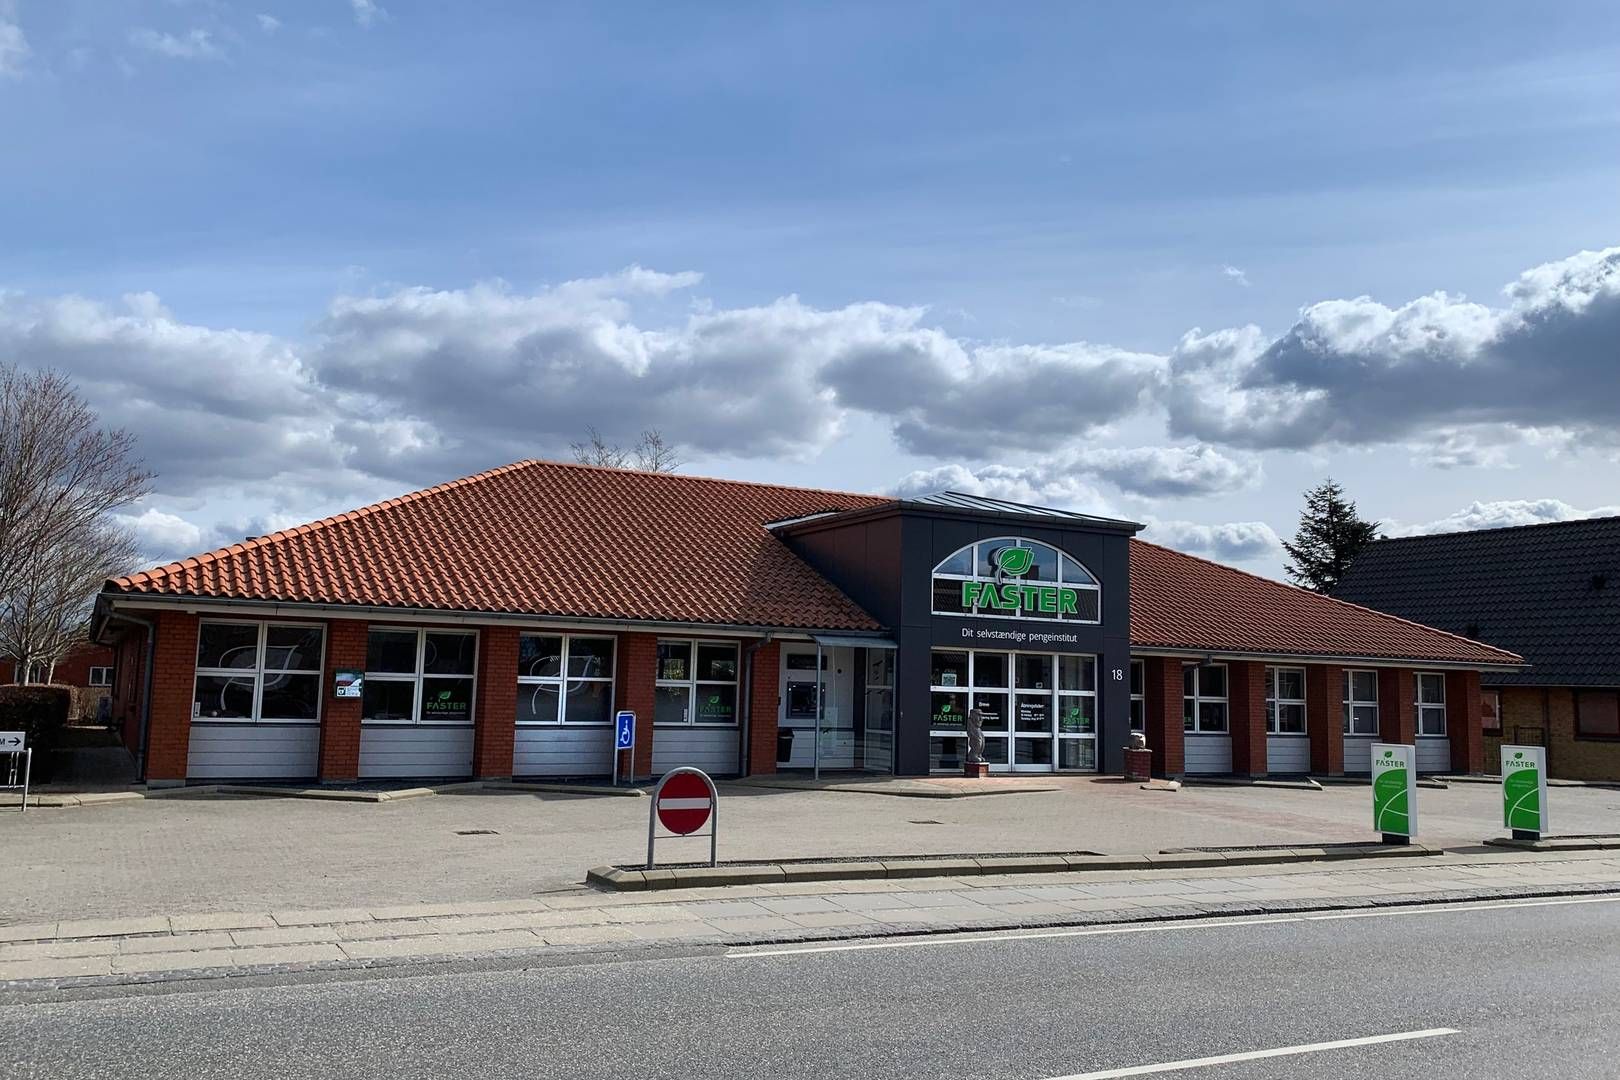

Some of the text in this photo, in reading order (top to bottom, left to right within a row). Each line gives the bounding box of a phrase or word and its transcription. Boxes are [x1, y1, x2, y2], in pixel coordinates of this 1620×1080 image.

[962, 581, 1078, 614] FASTER
[962, 628, 1078, 644] Dit selvstændige pengeinstitut
[1112, 669, 1123, 681] 18
[426, 702, 467, 710] FASTER
[1376, 759, 1405, 768] FASTER
[1505, 760, 1536, 769] FASTER
